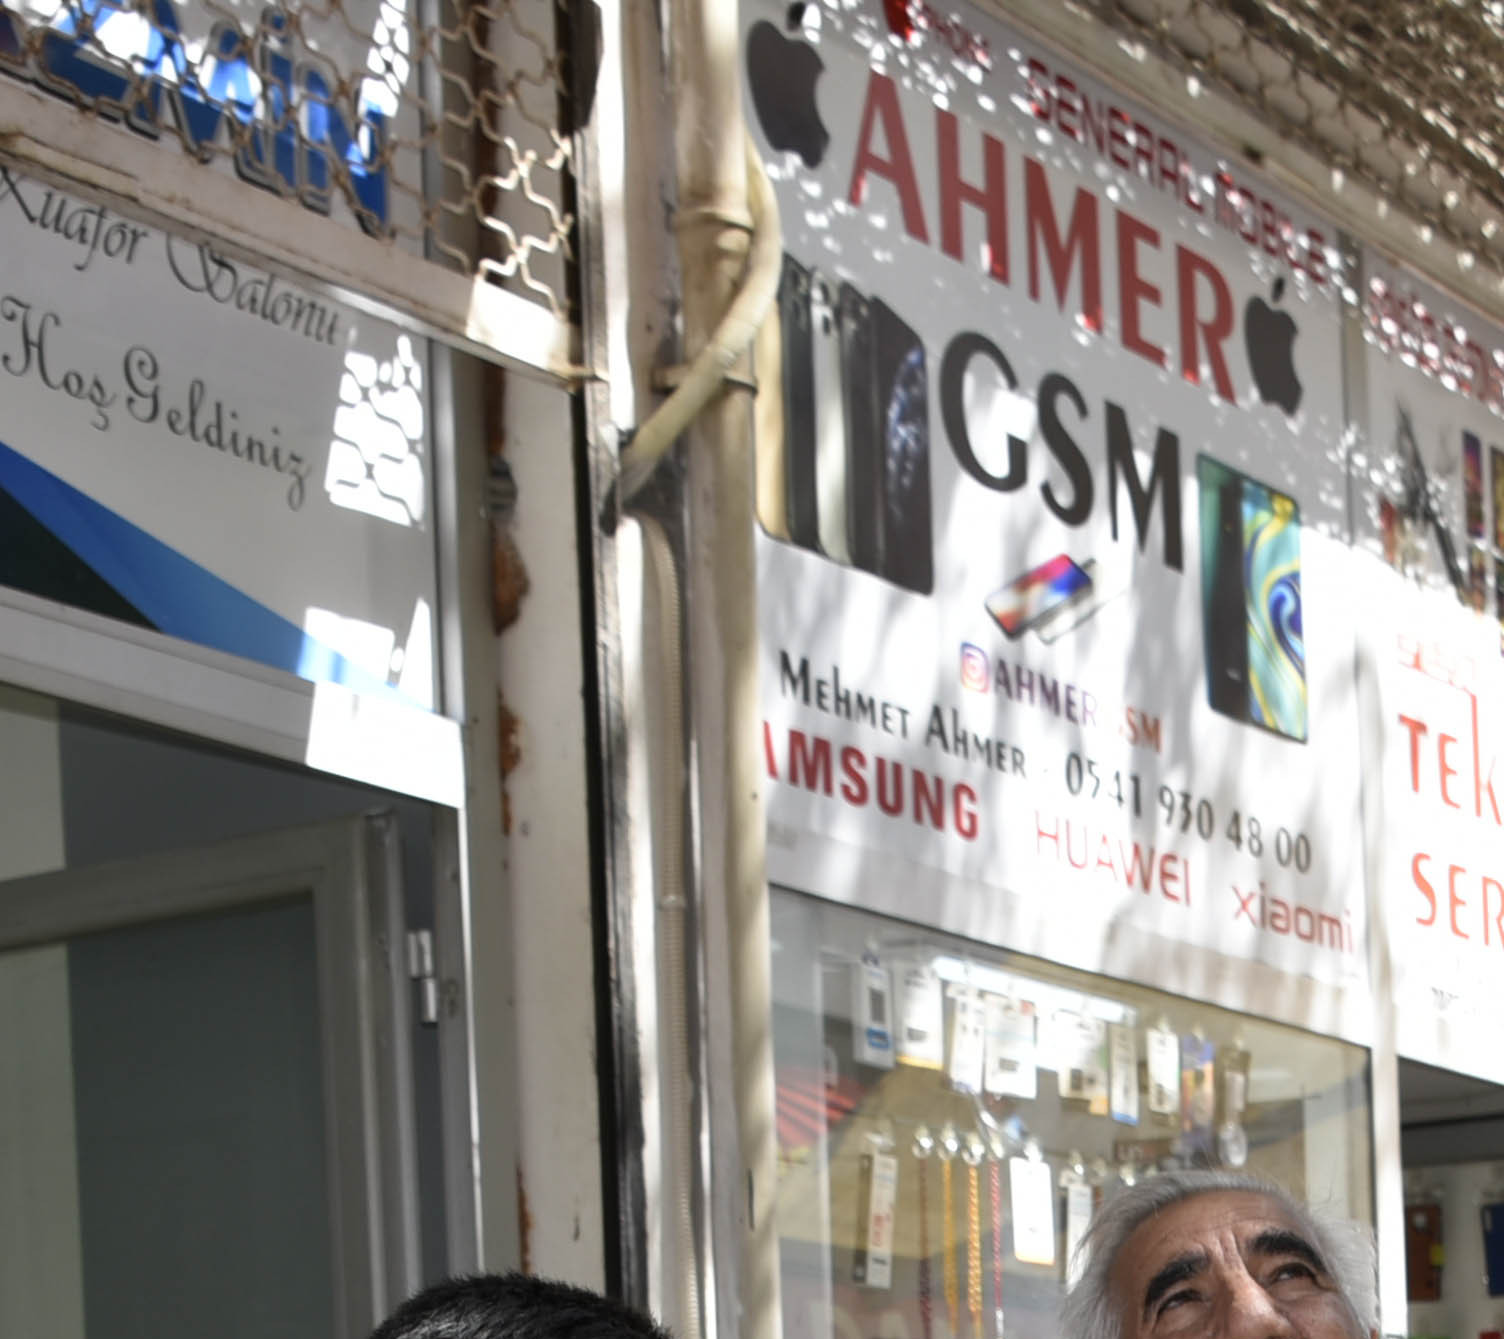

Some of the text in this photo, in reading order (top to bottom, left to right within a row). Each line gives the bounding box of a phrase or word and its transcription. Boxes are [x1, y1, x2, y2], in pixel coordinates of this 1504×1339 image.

[848, 66, 1238, 406] AHMER
[0, 295, 314, 512] Hoş Geldiniz
[940, 331, 1185, 573] GSM
[1033, 810, 1192, 907] HUAWEI
[1157, 784, 1214, 841] 930
[1225, 810, 1264, 860] 48
[1275, 828, 1312, 874] 00
[1232, 881, 1355, 955] xiaomi
